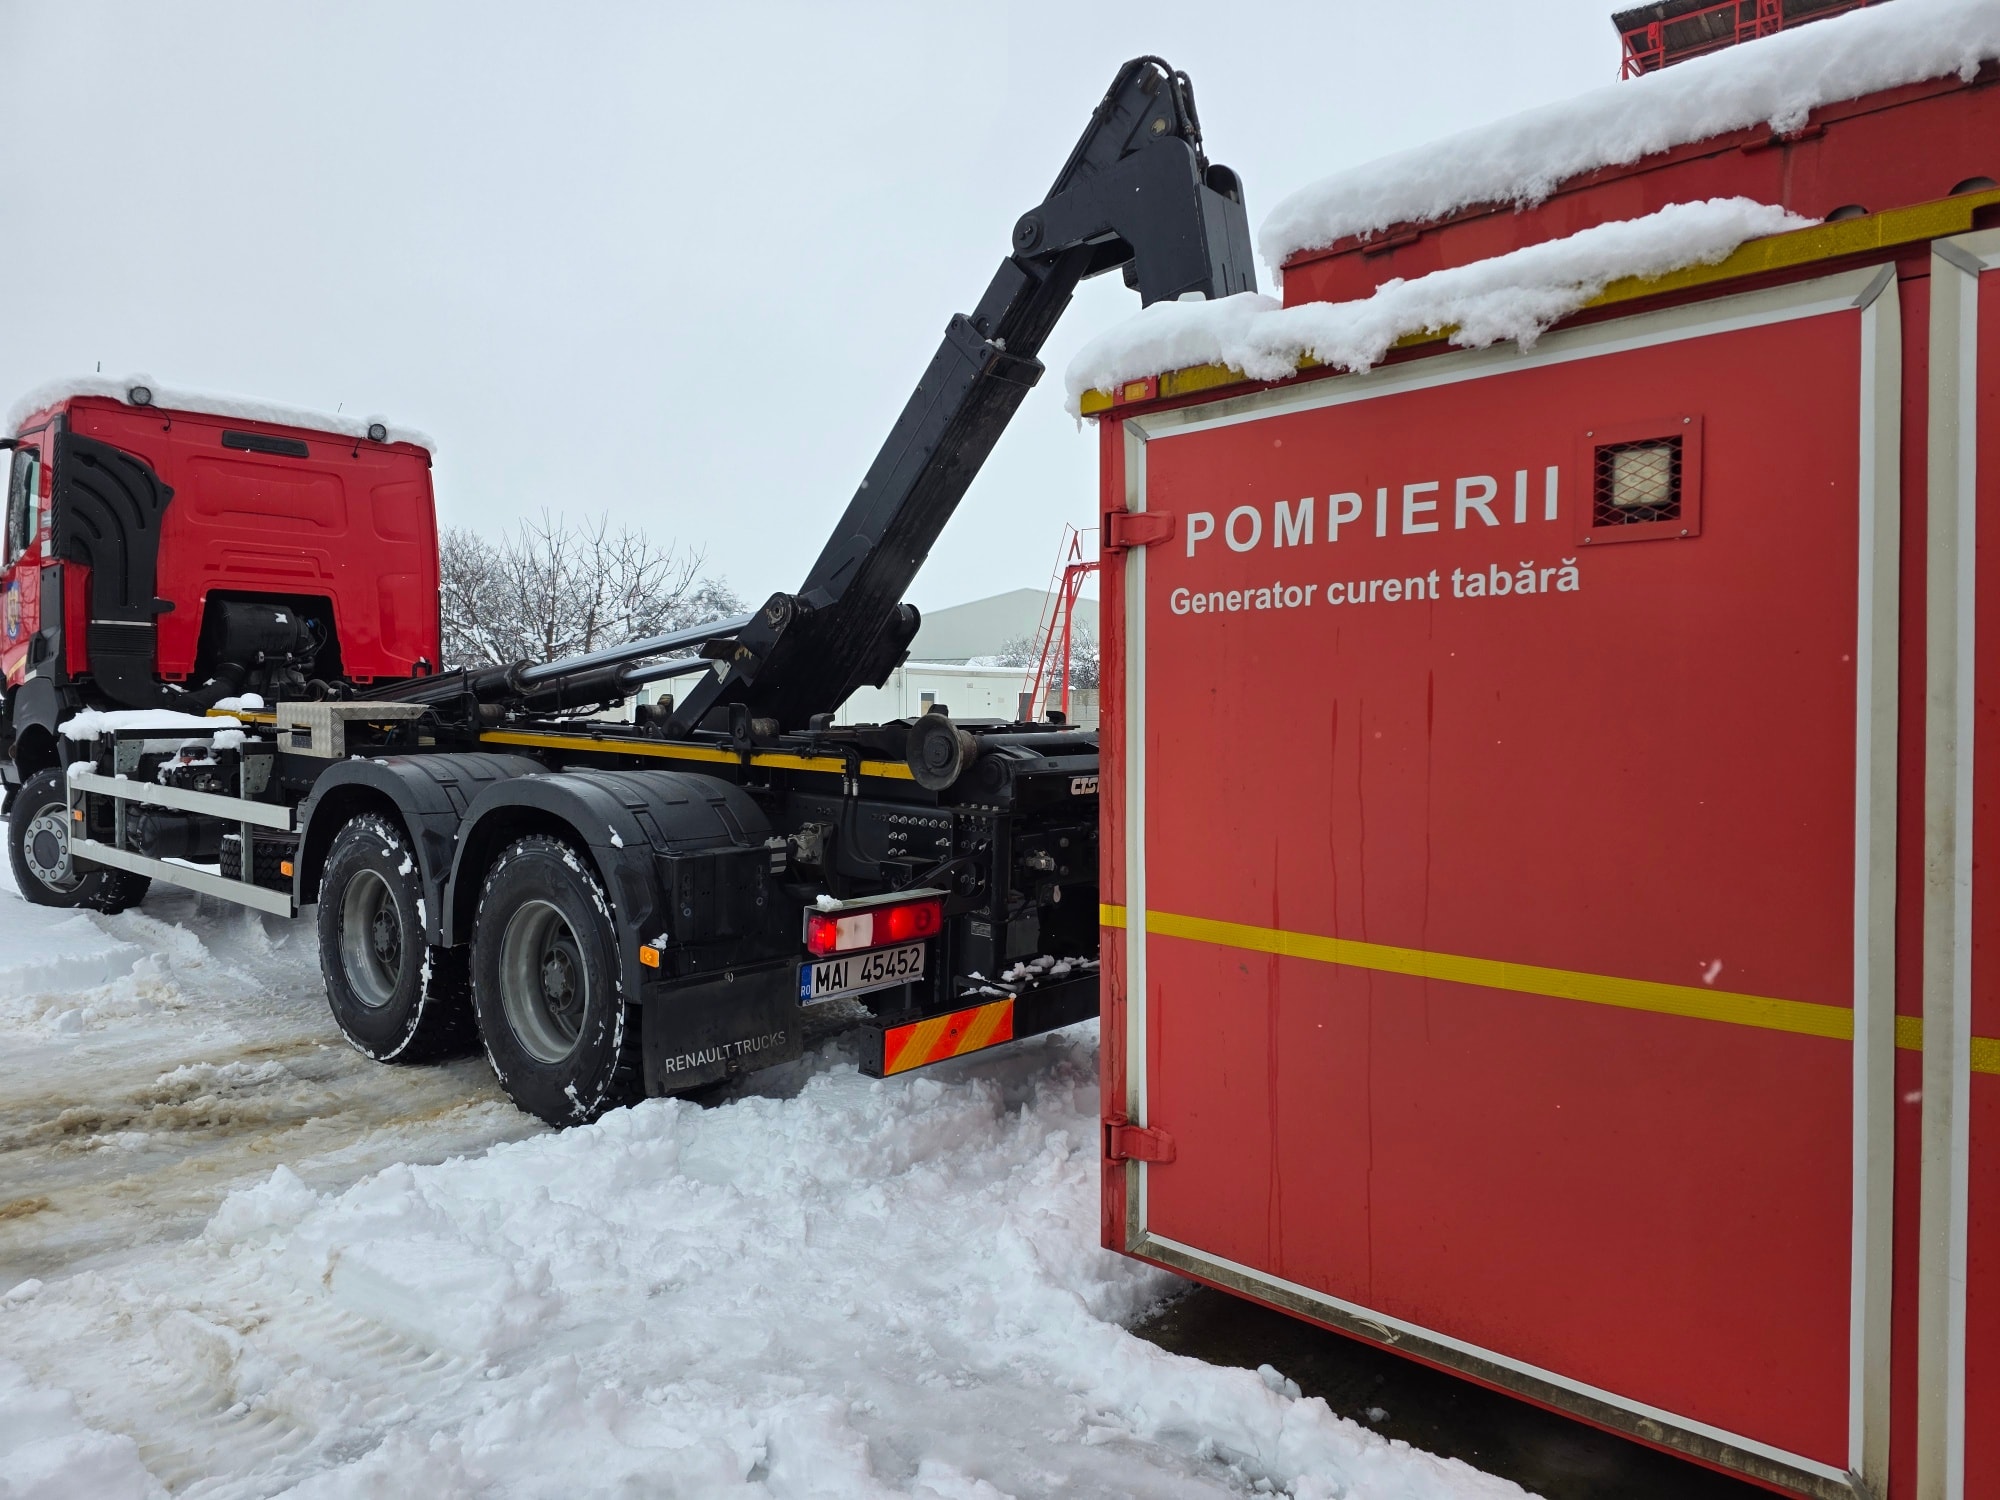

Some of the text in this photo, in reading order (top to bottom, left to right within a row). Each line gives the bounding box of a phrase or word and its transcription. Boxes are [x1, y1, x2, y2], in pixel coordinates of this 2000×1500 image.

[1186, 465, 1559, 558] POMPIERII
[1170, 557, 1580, 615] Generator curent tabără
[1070, 777, 1099, 796] CTS
[800, 985, 811, 997] RO
[815, 948, 920, 994] MAI 45452
[665, 1031, 786, 1074] RENAULT TRUCKS
